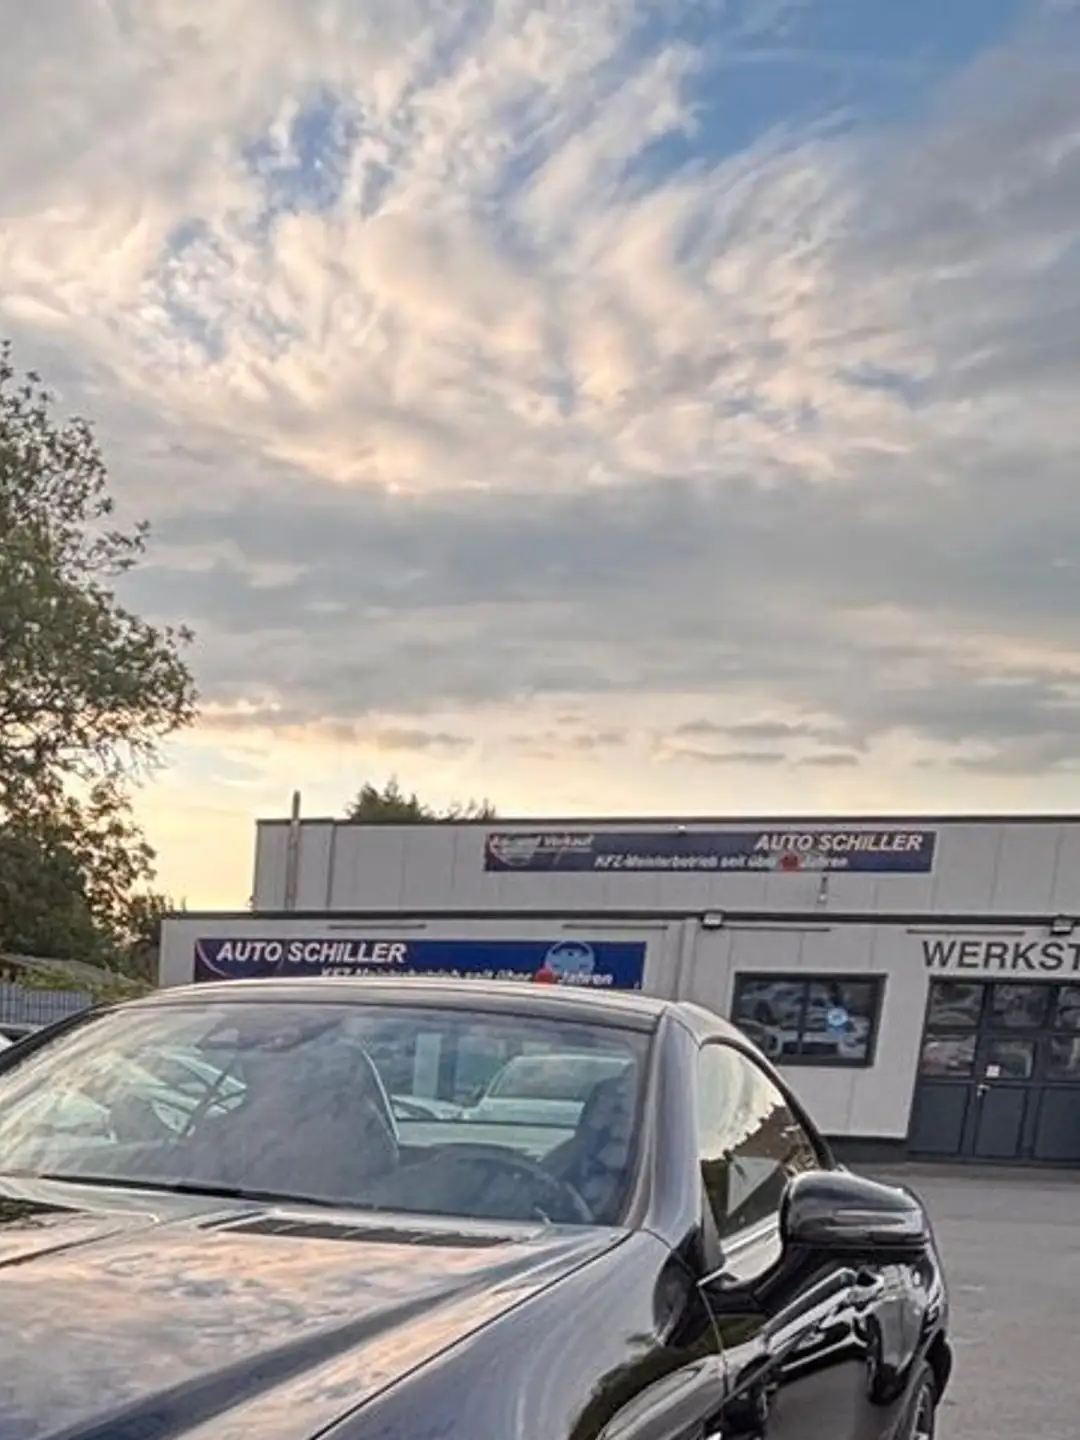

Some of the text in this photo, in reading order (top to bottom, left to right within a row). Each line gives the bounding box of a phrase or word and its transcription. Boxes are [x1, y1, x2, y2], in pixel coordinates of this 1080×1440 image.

[754, 834, 924, 851] AUTO SCHILLER
[216, 941, 408, 964] AUTO SCHILLER
